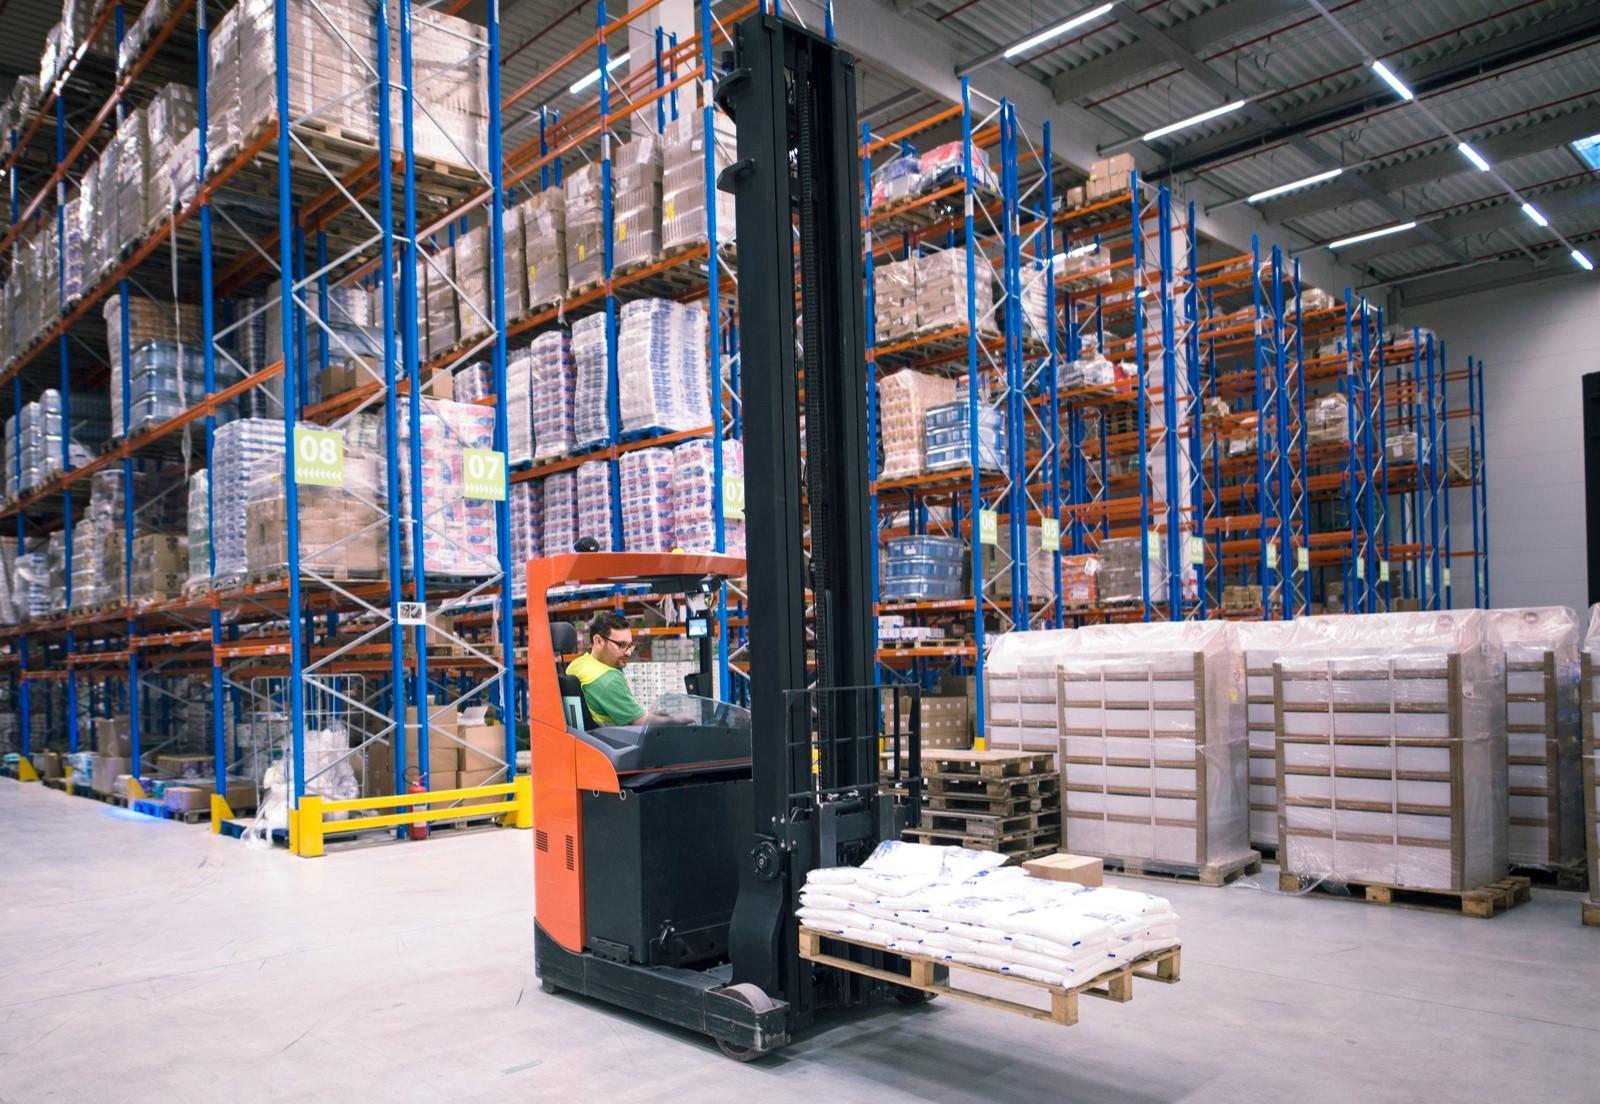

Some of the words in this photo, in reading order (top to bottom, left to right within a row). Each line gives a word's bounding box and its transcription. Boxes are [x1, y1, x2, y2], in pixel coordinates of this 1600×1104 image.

[301, 435, 337, 465] 08
[468, 454, 500, 480] 07
[982, 514, 996, 531] 06
[1044, 522, 1057, 538] 05
